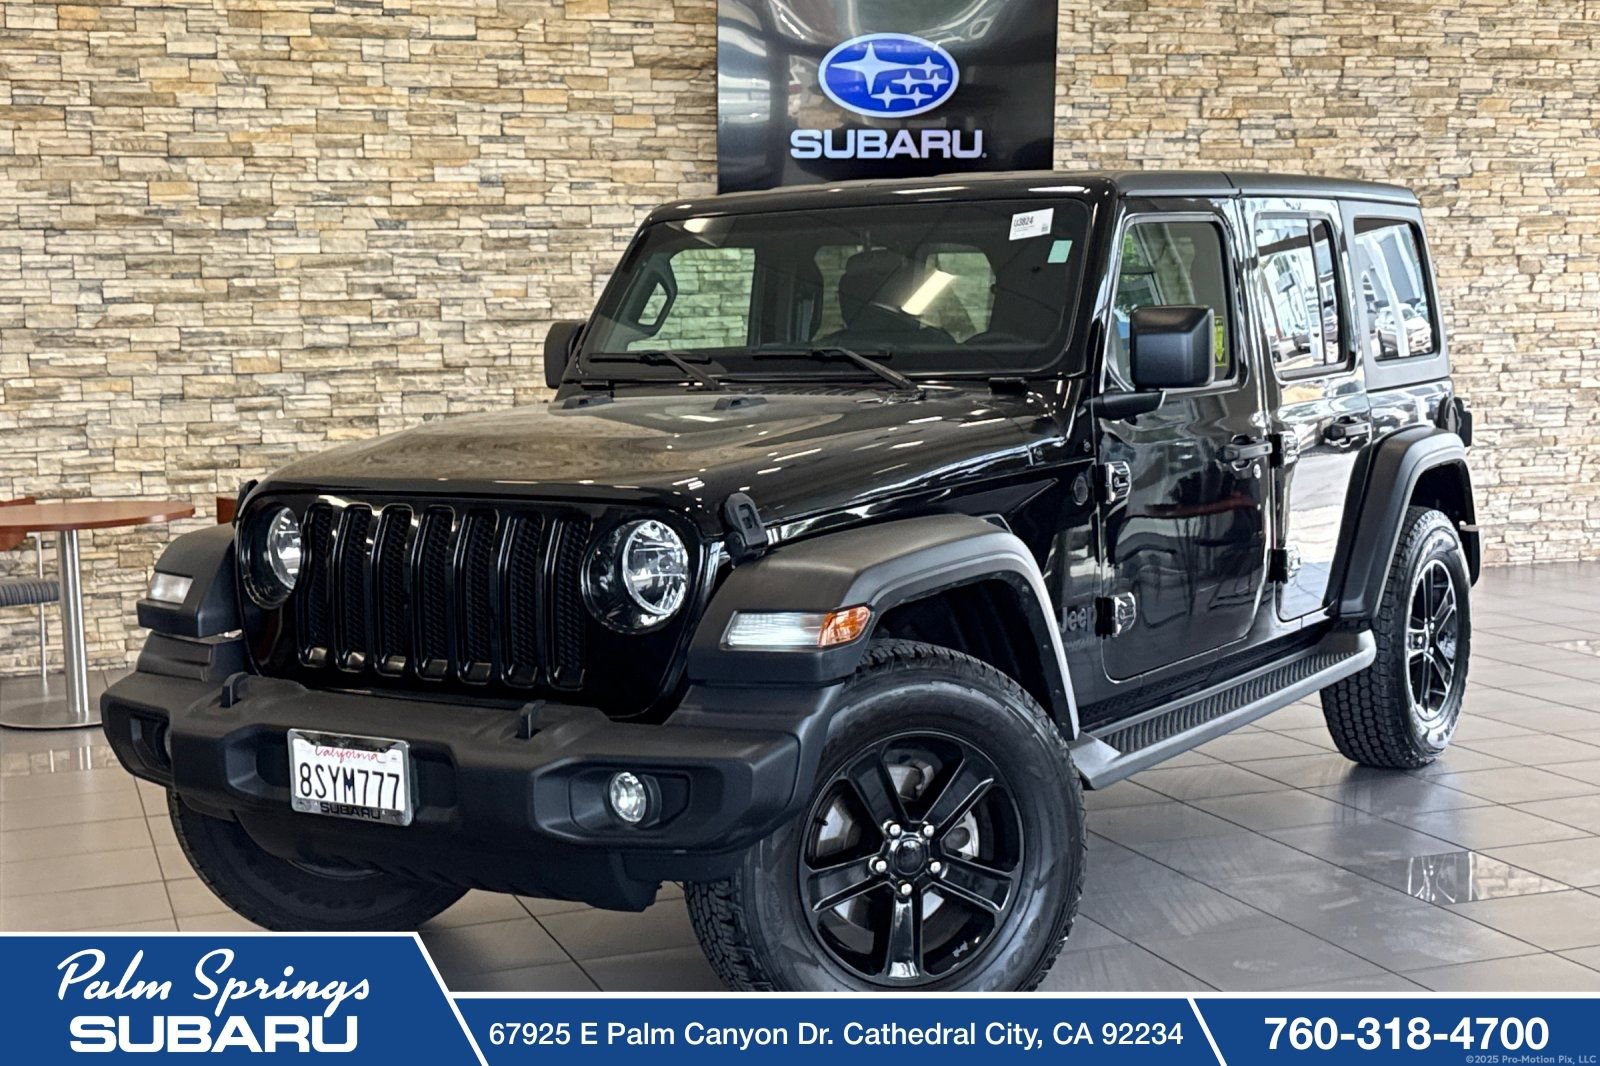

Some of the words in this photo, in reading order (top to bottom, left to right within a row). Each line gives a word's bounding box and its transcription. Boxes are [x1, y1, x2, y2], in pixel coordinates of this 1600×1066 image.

[790, 129, 983, 159] SUBARU
[1058, 606, 1097, 634] Jeep
[300, 762, 400, 810] 8SYM777
[320, 802, 381, 820] SUBARU
